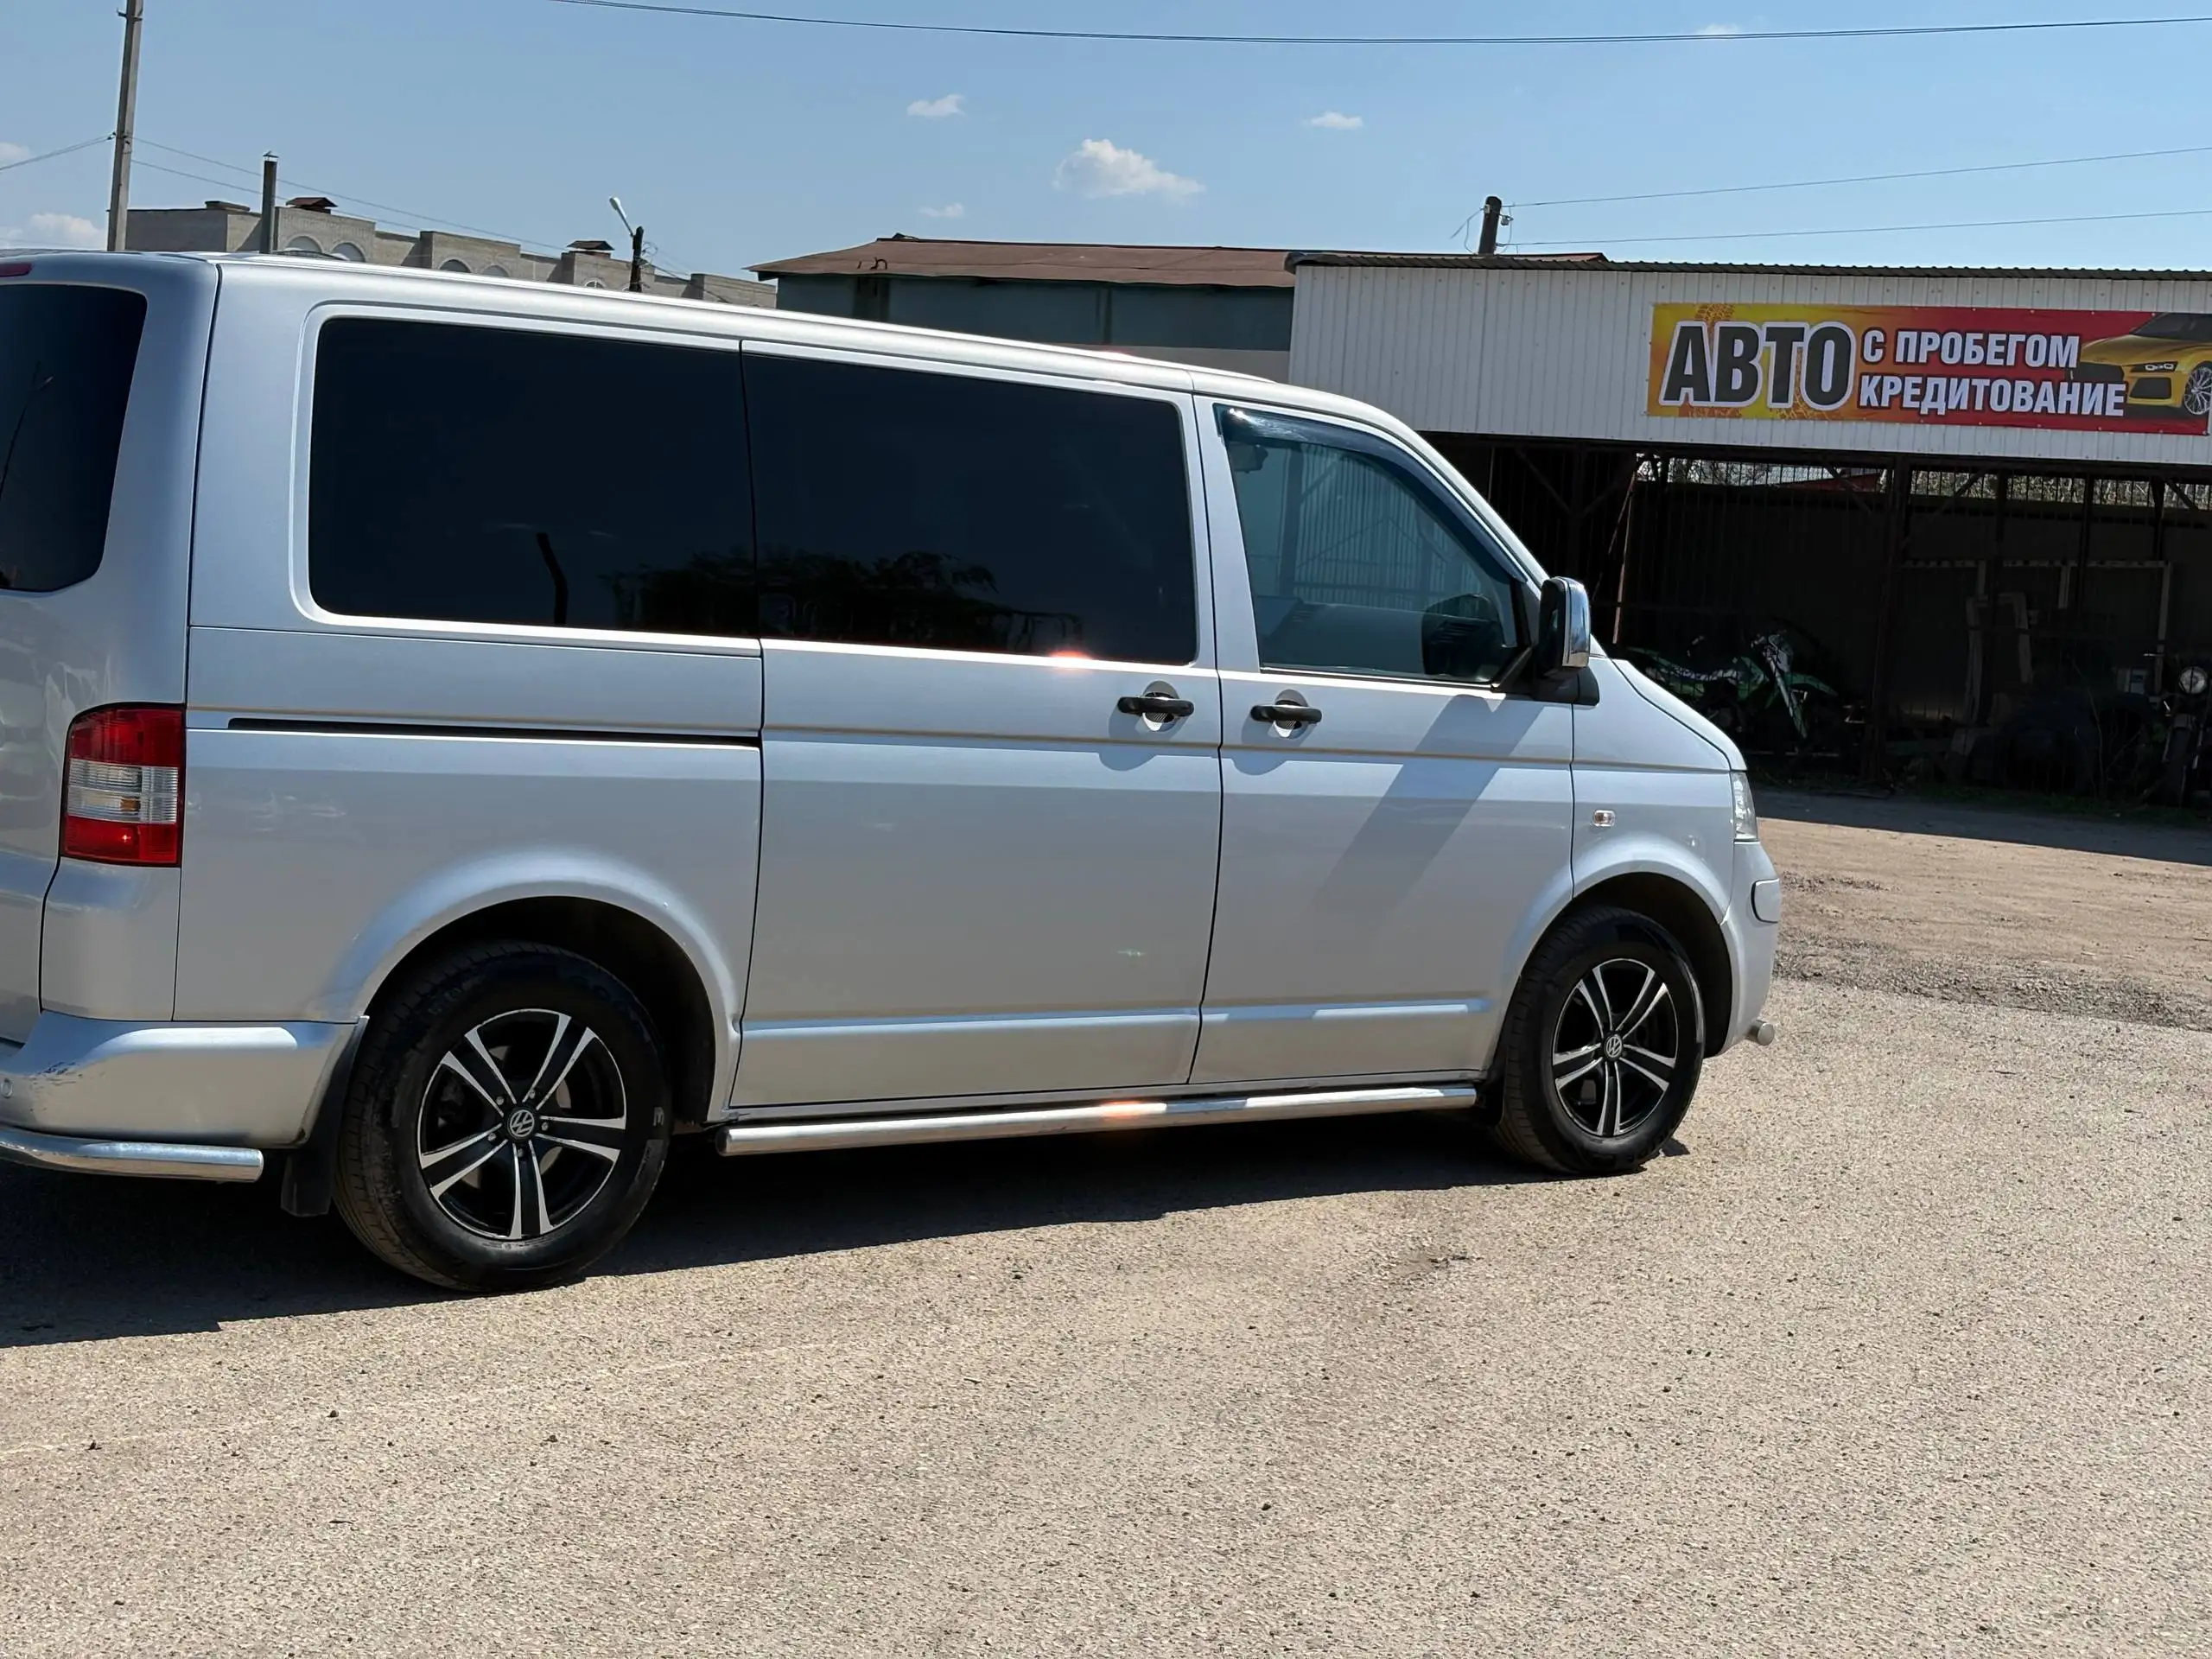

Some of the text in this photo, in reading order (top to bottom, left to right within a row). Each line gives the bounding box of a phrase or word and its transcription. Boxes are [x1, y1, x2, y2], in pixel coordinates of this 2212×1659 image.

[1659, 321, 1856, 410] АВТО
[1863, 329, 2080, 368] С ПРОБЕГОМ
[1859, 375, 2126, 416] КРЕДИТОВАНИЕ
[510, 1109, 534, 1137] VW
